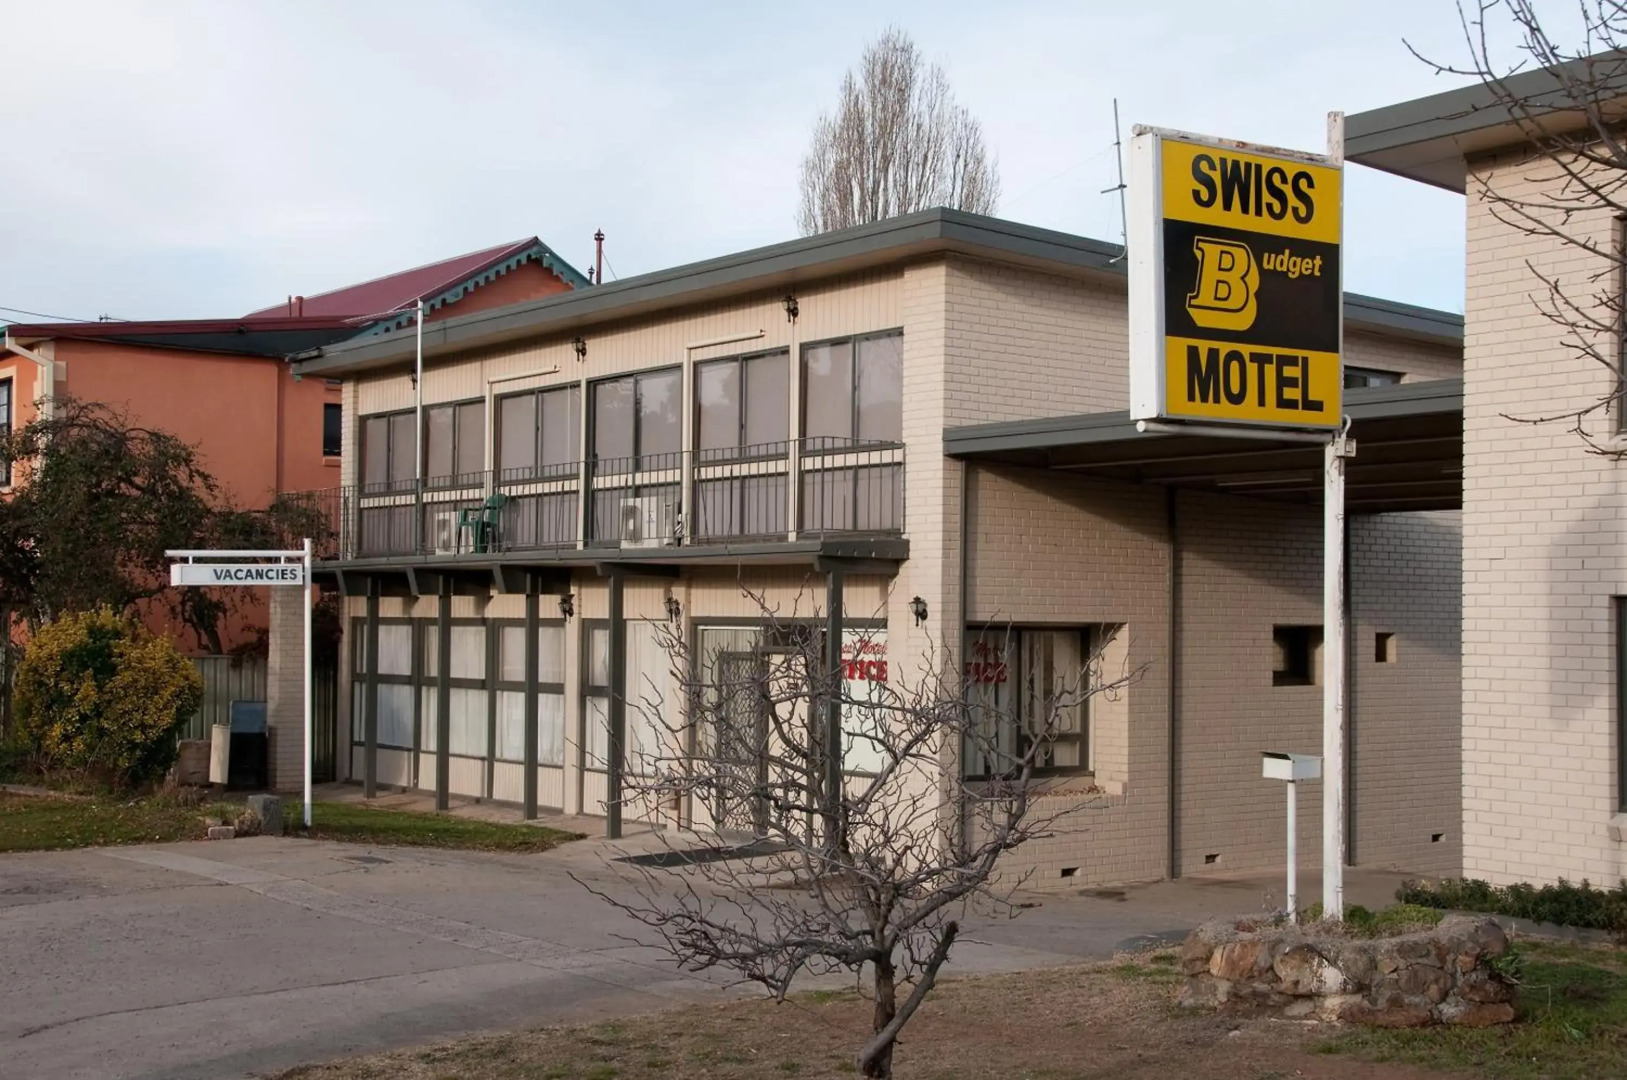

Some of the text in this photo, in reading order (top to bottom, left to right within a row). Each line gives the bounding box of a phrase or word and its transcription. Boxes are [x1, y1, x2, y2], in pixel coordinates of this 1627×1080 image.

[1191, 154, 1315, 224] SWISS
[1186, 345, 1324, 412] MOTEL
[213, 568, 298, 581] VACANCIES
